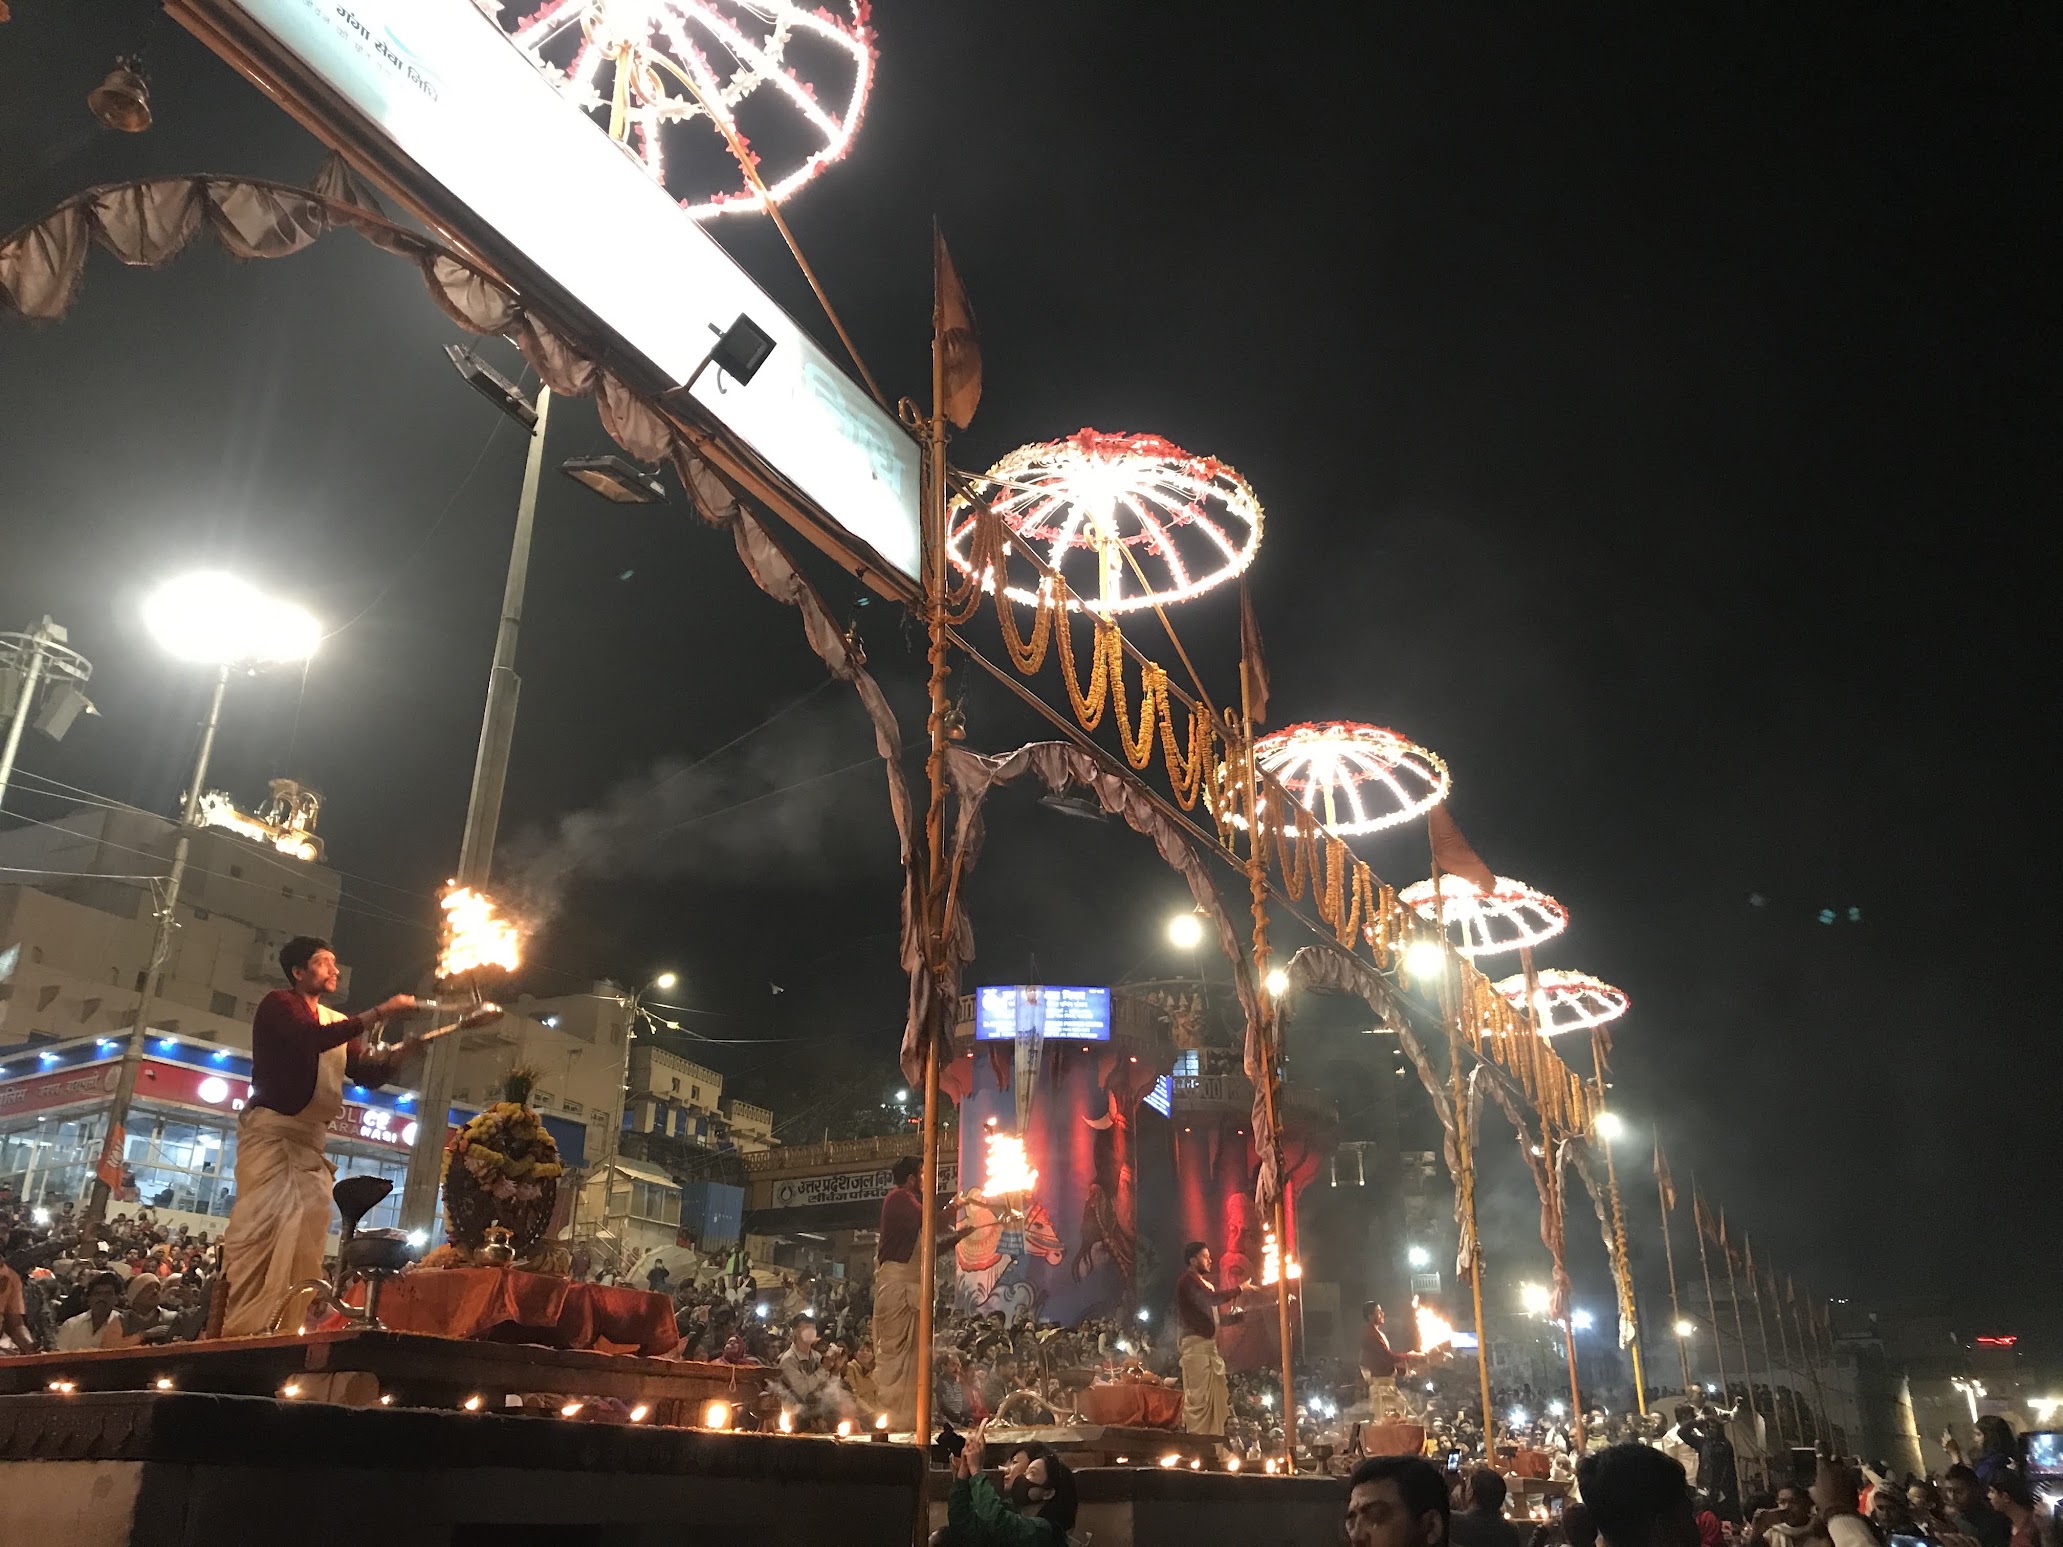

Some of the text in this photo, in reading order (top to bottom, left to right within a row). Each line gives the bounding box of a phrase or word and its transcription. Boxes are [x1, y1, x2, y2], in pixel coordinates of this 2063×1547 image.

[336, 3, 371, 41] गंगा
[374, 37, 404, 70] सेवा
[407, 65, 440, 103] निधि
[335, 1105, 391, 1131] OLICE
[327, 1120, 398, 1144] ARANASI
[797, 1171, 893, 1194] उत्तर प्रदेश जल निग
